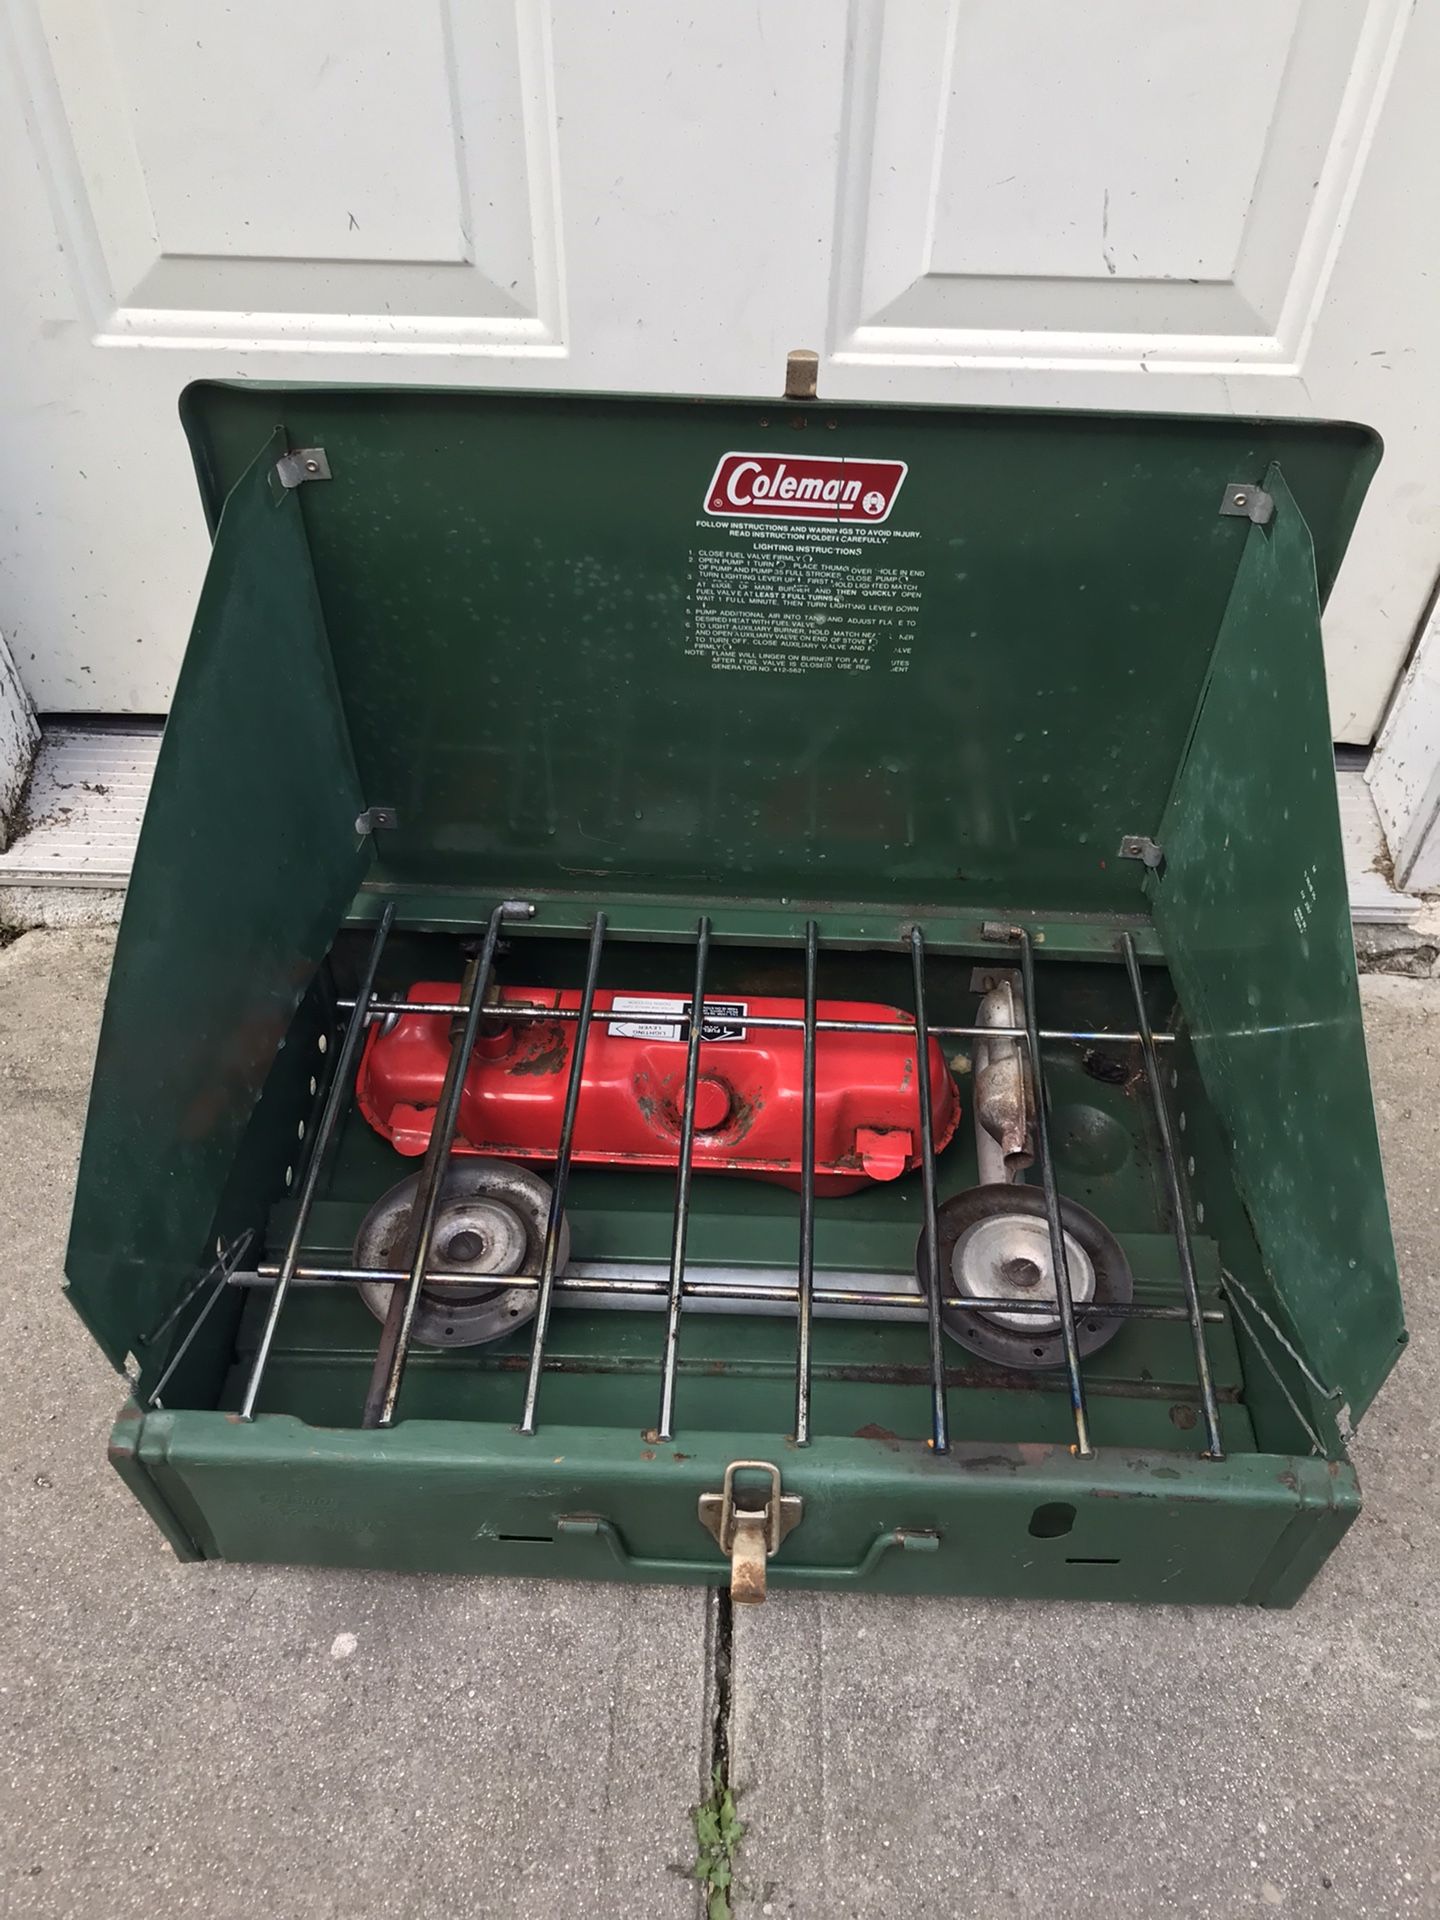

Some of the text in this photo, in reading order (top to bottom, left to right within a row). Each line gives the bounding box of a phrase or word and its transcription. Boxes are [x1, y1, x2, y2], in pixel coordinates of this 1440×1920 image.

[726, 461, 863, 506] Coleman
[696, 521, 730, 529] FOLLOW
[730, 522, 788, 532] INSTRUCTIONS
[867, 529, 892, 537] AVOID
[893, 530, 922, 538] INJURY.
[752, 532, 804, 540] INSTRUCTION
[754, 543, 862, 556] LIGHTING INSTRUCTIONS
